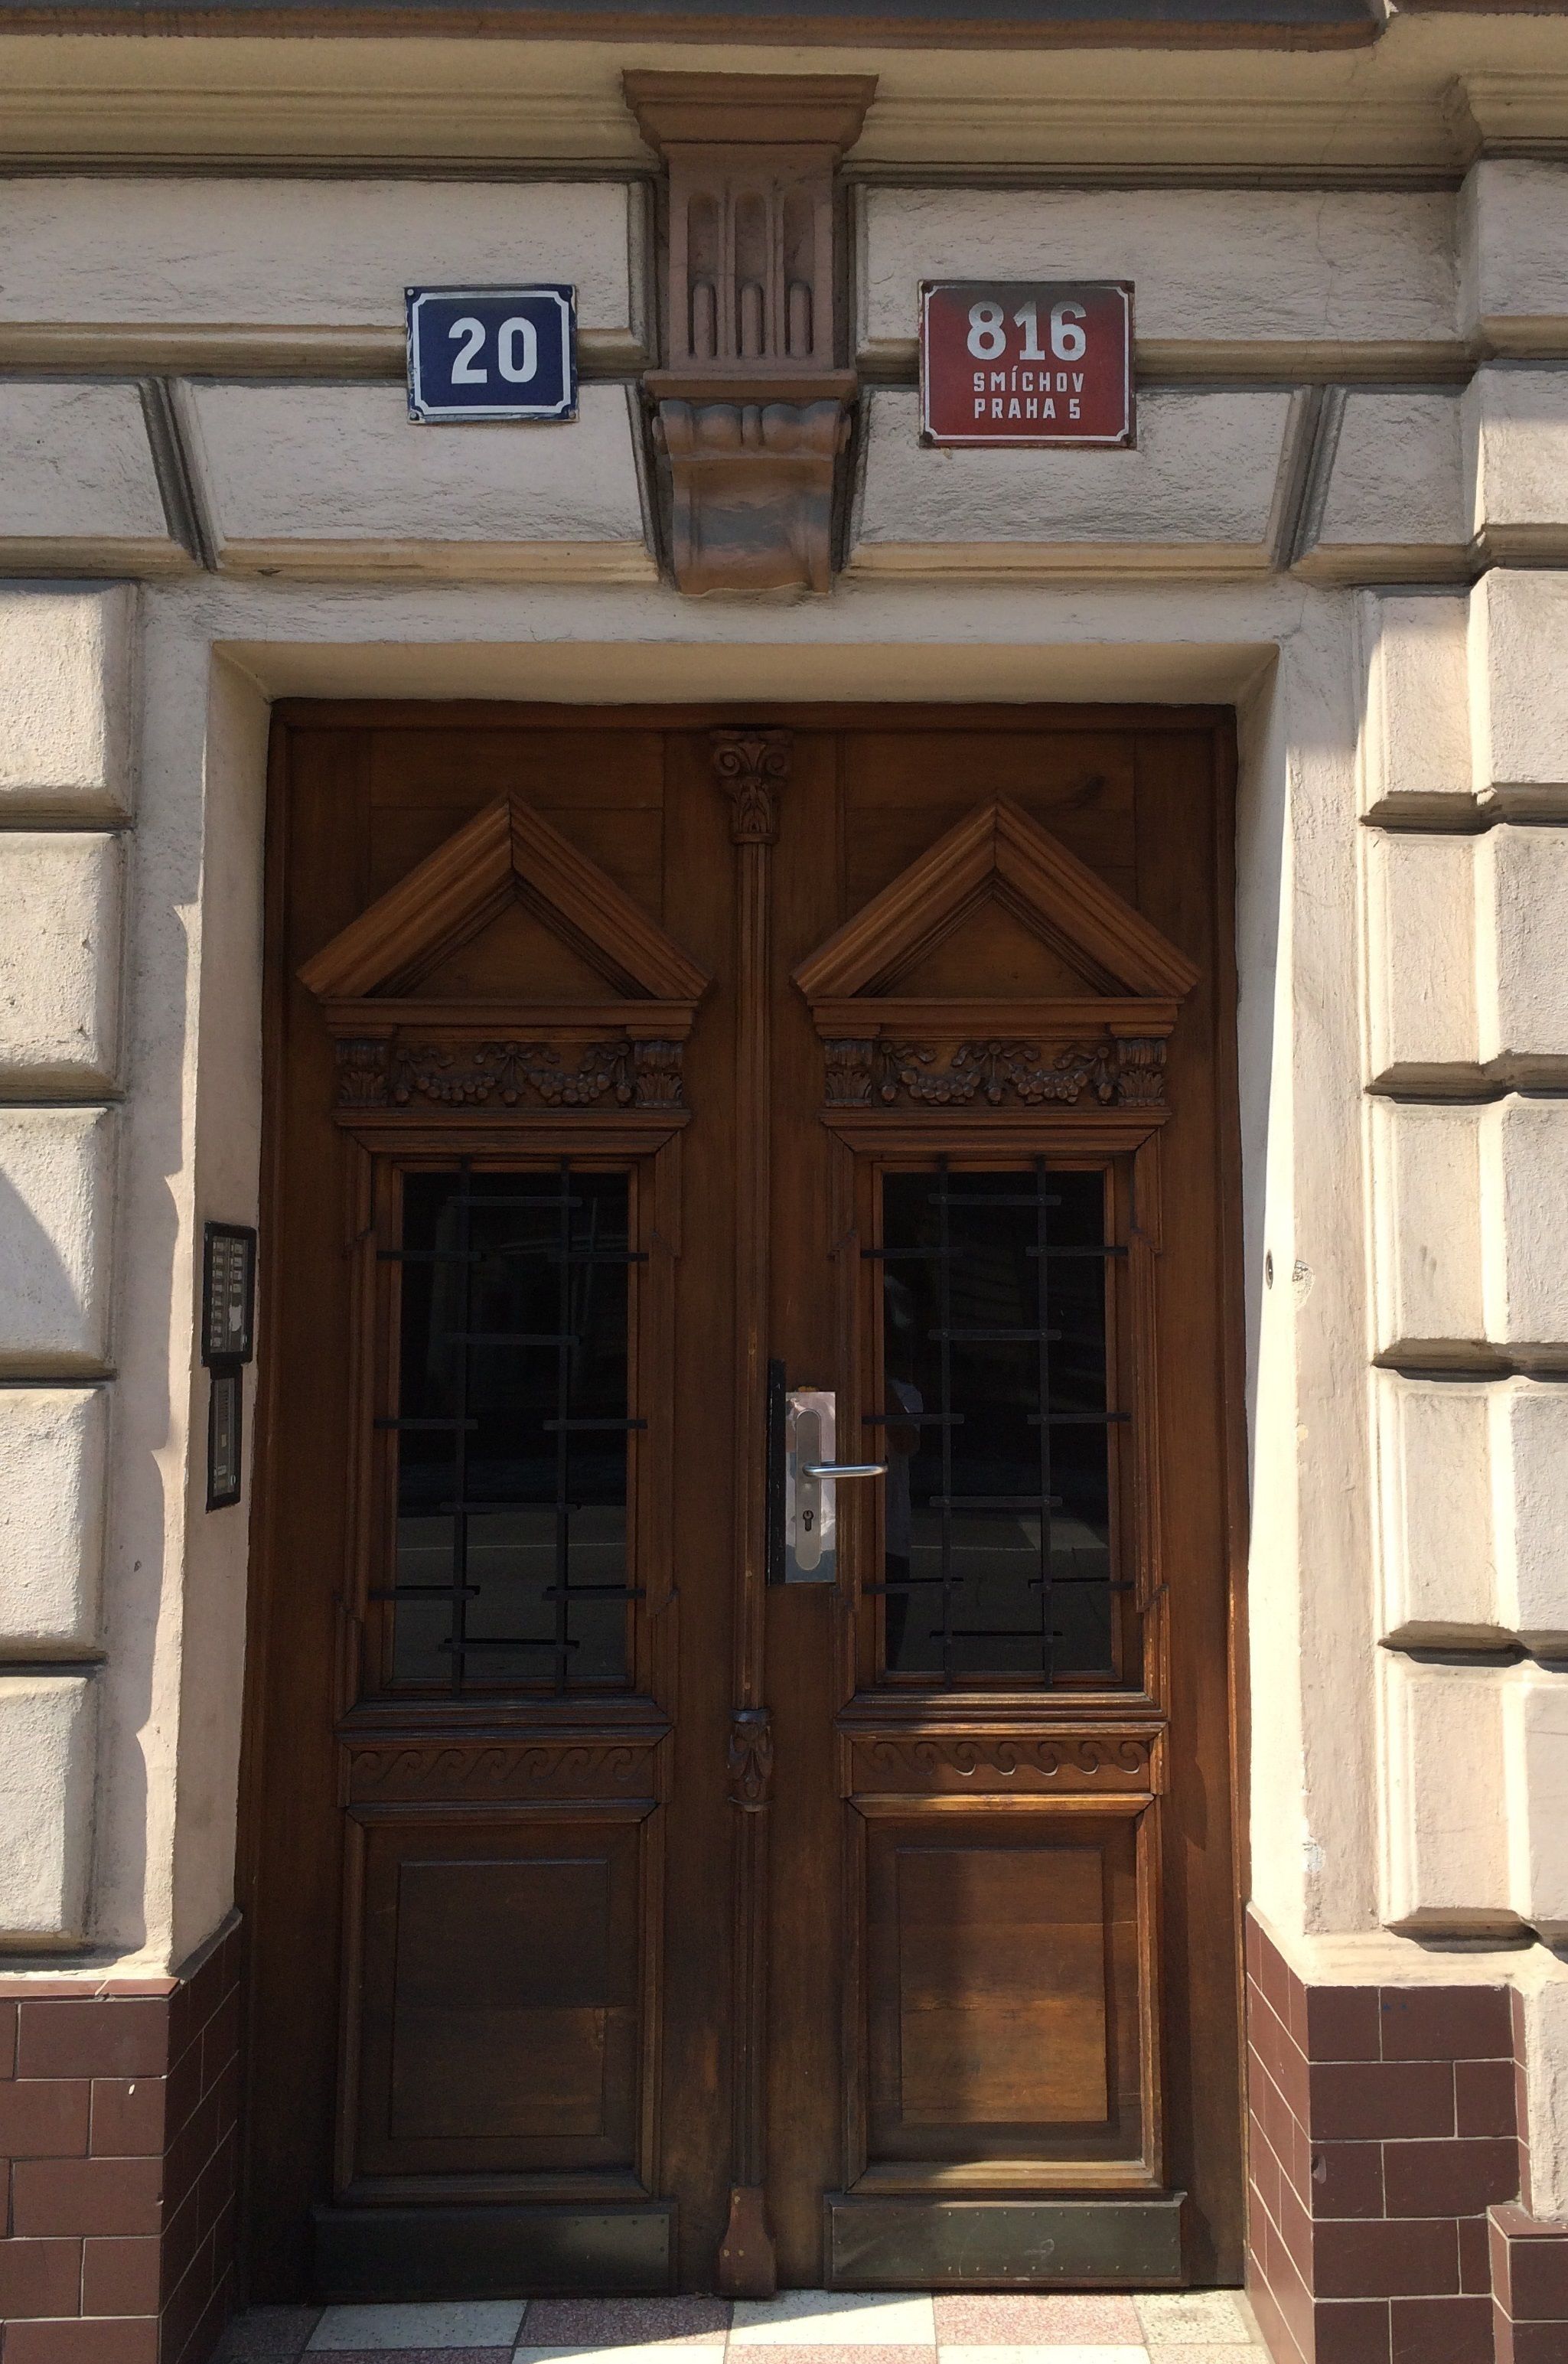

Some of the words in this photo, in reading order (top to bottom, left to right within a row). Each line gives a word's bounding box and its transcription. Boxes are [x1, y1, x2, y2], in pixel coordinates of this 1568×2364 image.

[448, 317, 537, 384] 20
[967, 301, 1087, 361] 816
[973, 366, 1084, 393] SMÍCHOV
[974, 398, 1056, 419] PRAHA
[1069, 399, 1081, 419] 5
